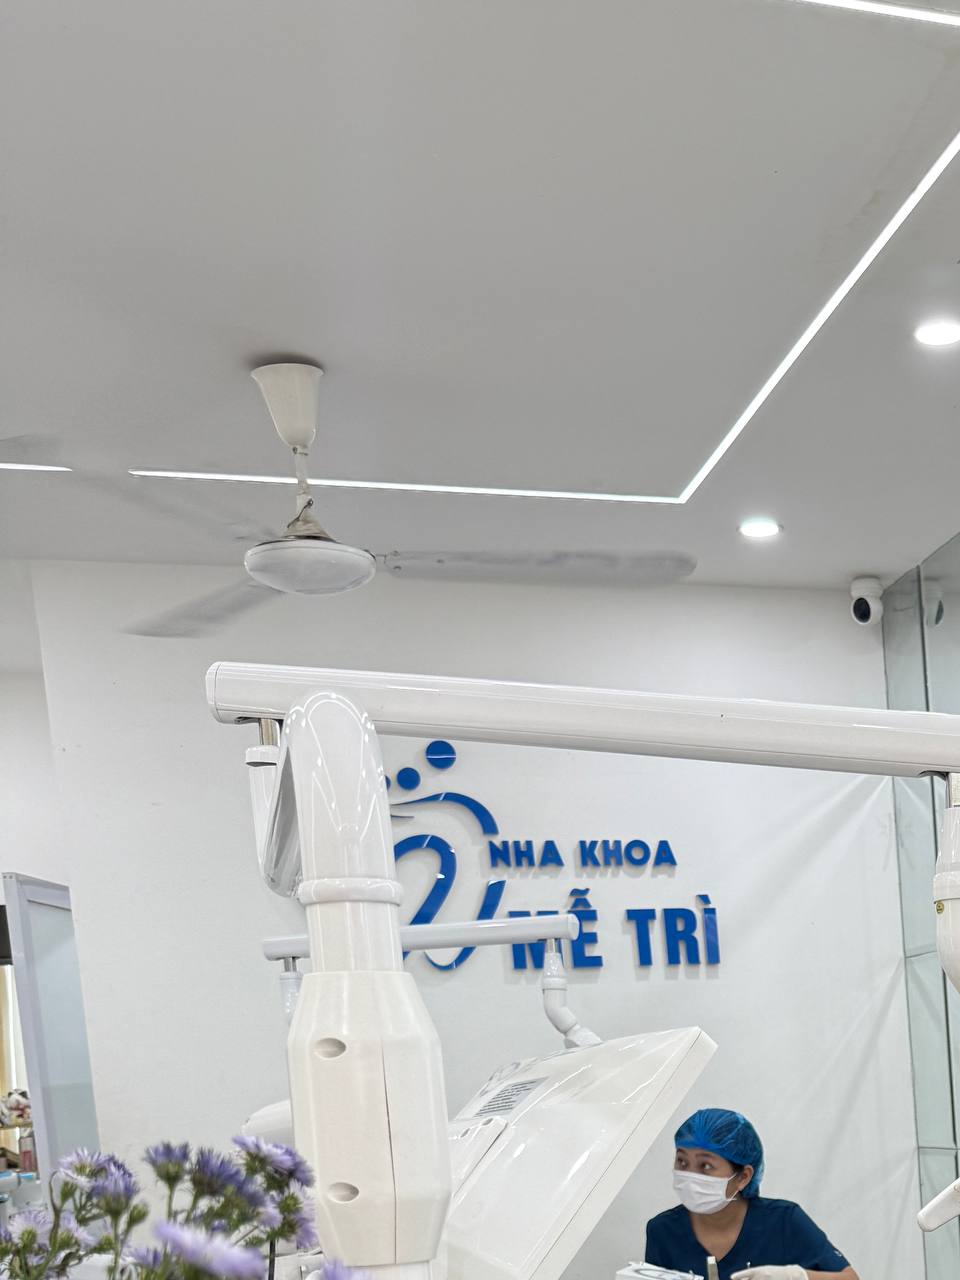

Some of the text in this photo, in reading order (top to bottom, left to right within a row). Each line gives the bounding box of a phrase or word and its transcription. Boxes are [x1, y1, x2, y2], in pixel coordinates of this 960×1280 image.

[488, 840, 677, 867] NHA KHOA
[626, 894, 720, 967] TRÌ
